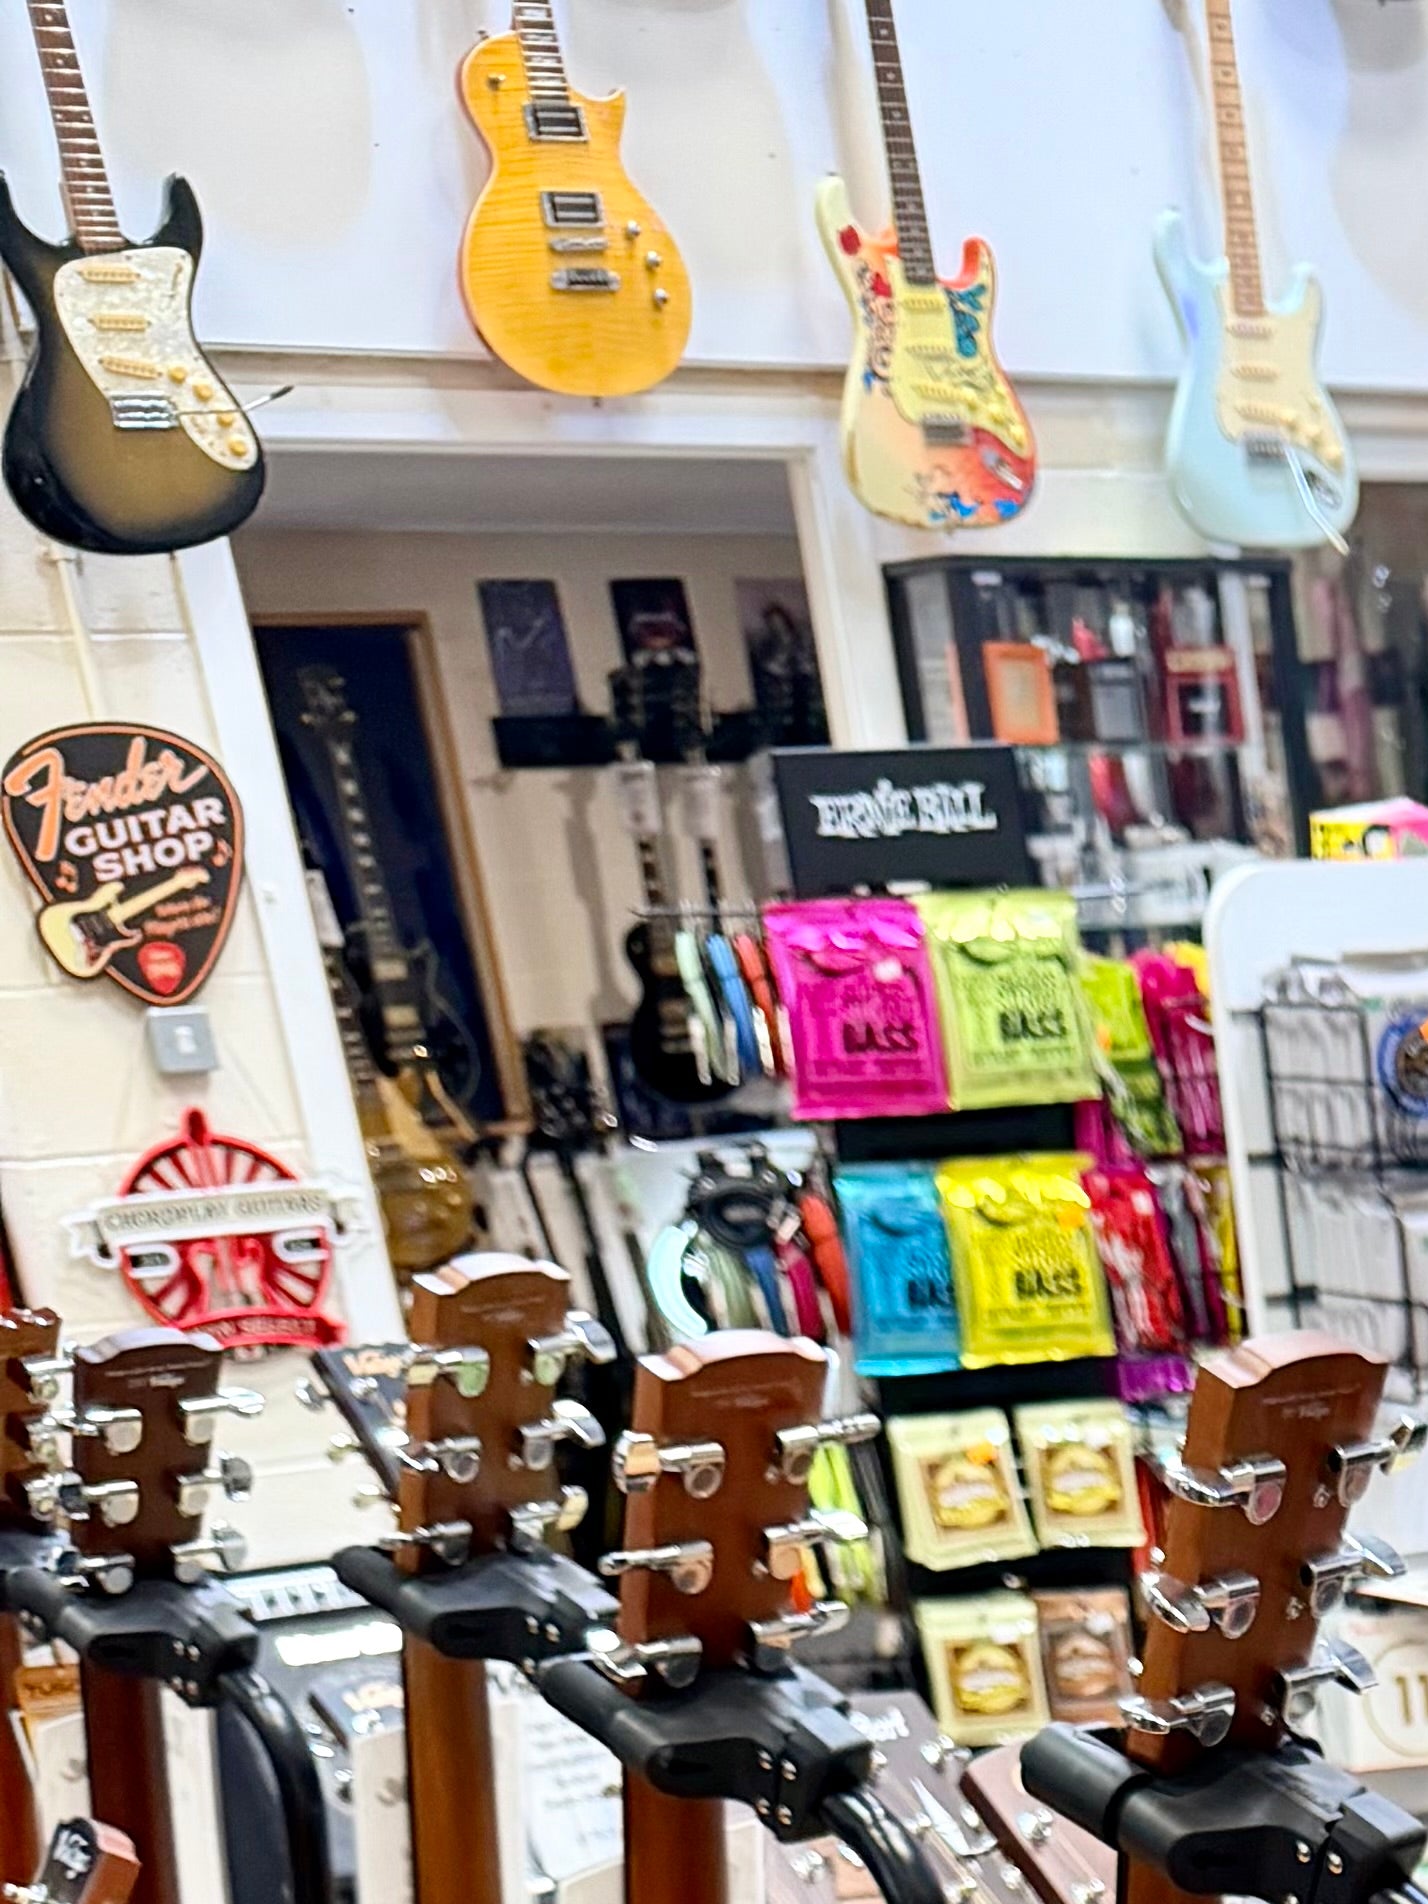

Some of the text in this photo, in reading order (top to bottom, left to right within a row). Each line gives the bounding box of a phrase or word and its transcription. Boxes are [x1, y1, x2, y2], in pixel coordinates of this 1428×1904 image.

[5, 736, 208, 862] Fender
[64, 797, 225, 856] GUITAR
[809, 777, 998, 838] ERNIE BALL
[92, 831, 213, 881] SHOP
